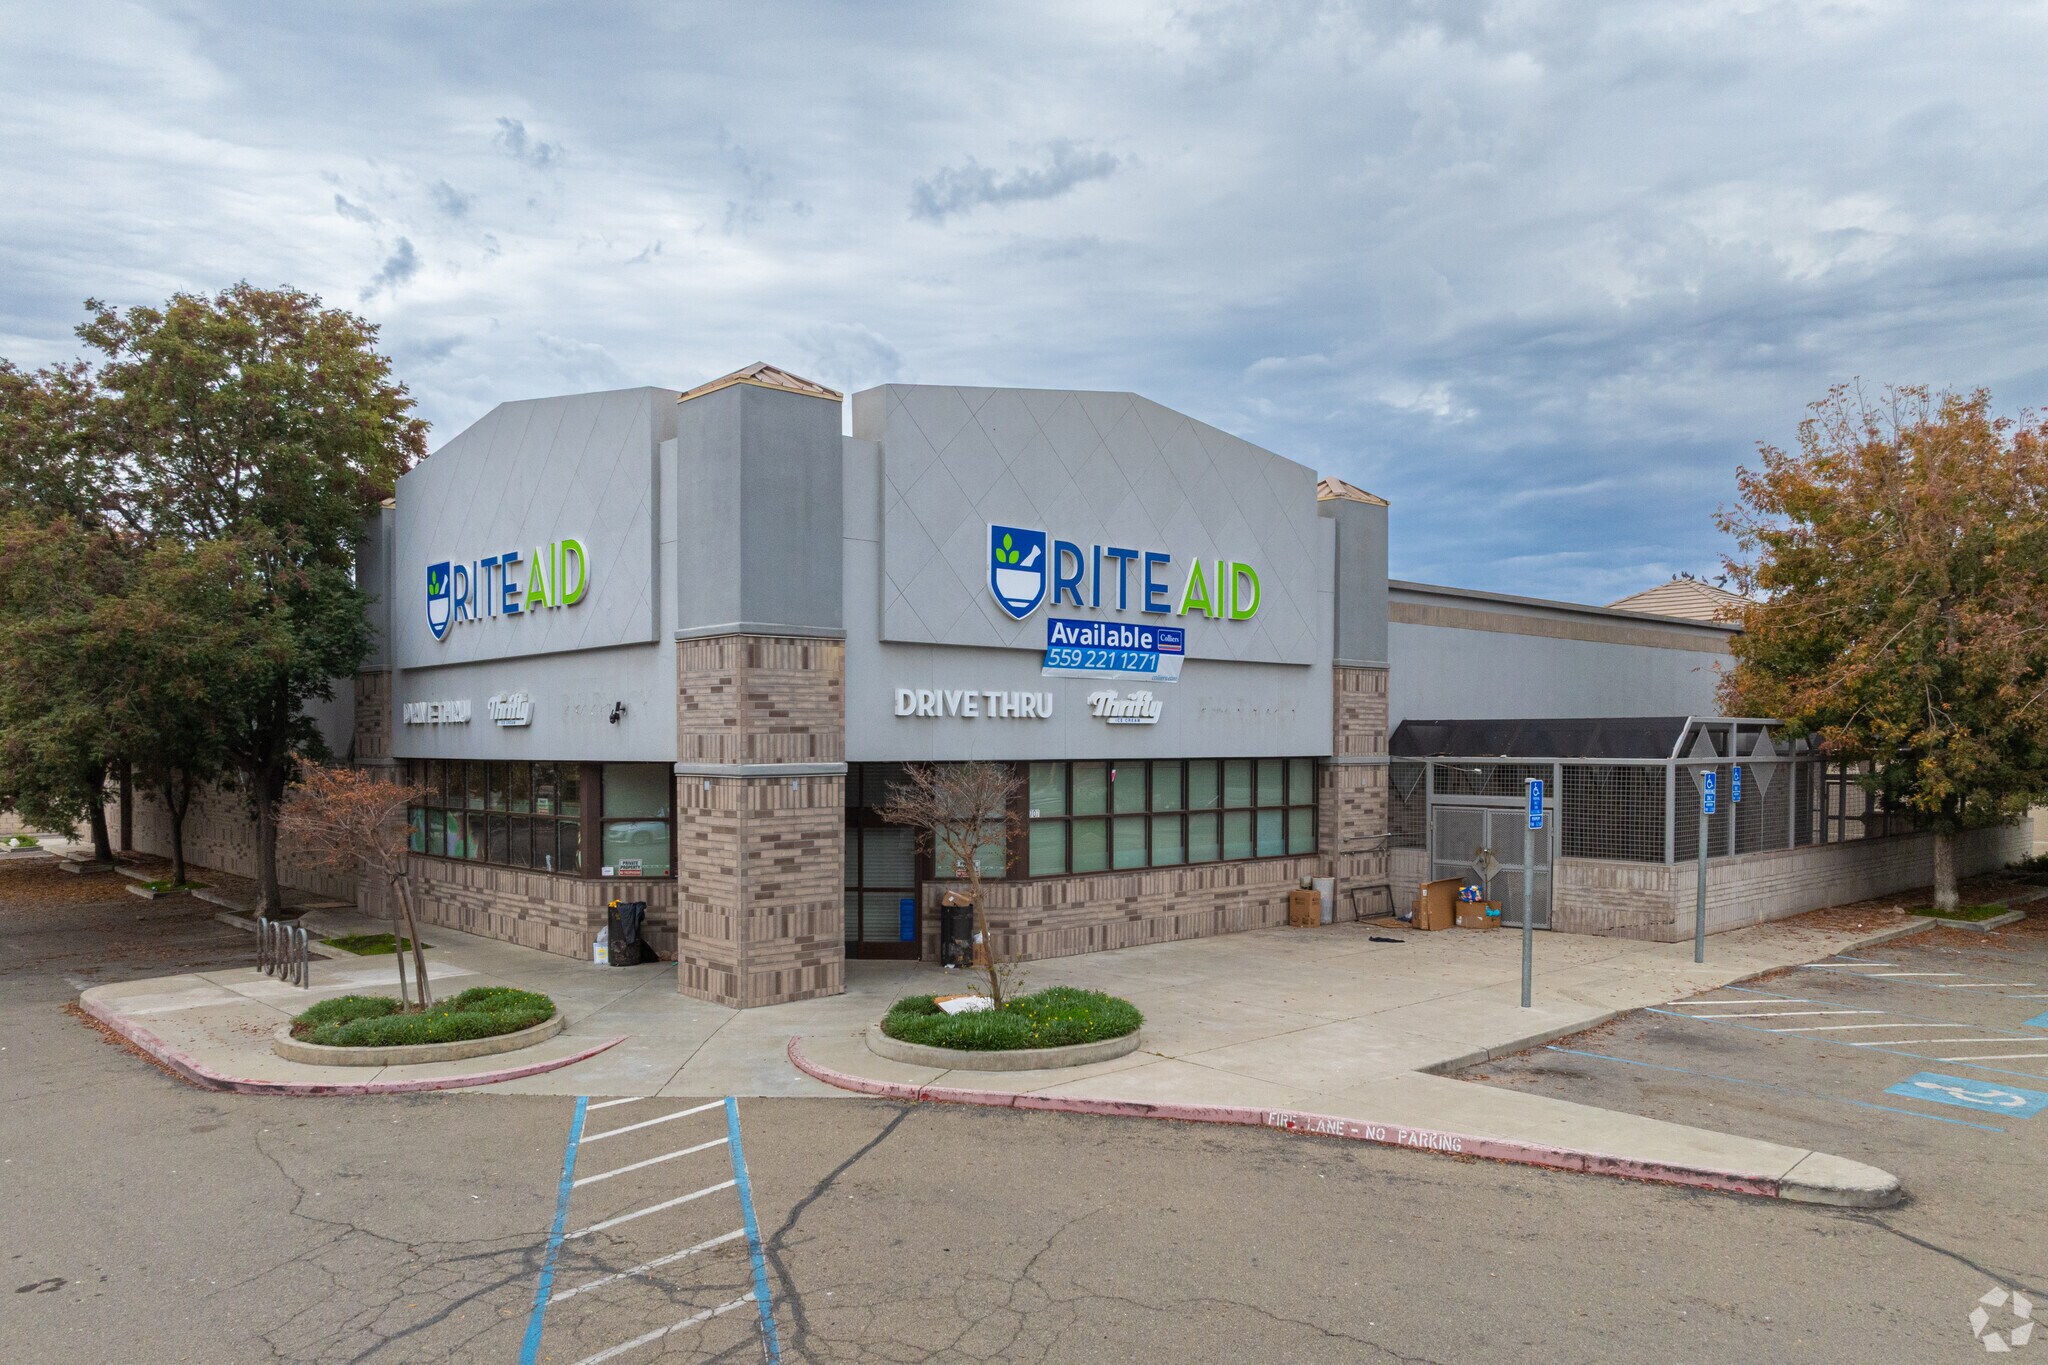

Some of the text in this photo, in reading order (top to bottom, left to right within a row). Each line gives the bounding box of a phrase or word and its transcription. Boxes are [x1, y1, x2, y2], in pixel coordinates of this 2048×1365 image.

[454, 537, 592, 624] RITE AID
[1050, 539, 1261, 620] RITE AID
[1051, 622, 1153, 649] Available
[1160, 634, 1179, 643] Colliers
[1048, 648, 1156, 671] 559 221 1271
[894, 687, 1053, 719] DRIVE THRU
[1087, 690, 1163, 723] Thrifty
[1268, 1112, 1297, 1129] FIRE
[1307, 1117, 1344, 1136] LANE
[1365, 1126, 1386, 1141] NO
[1398, 1130, 1462, 1153] PARKING
